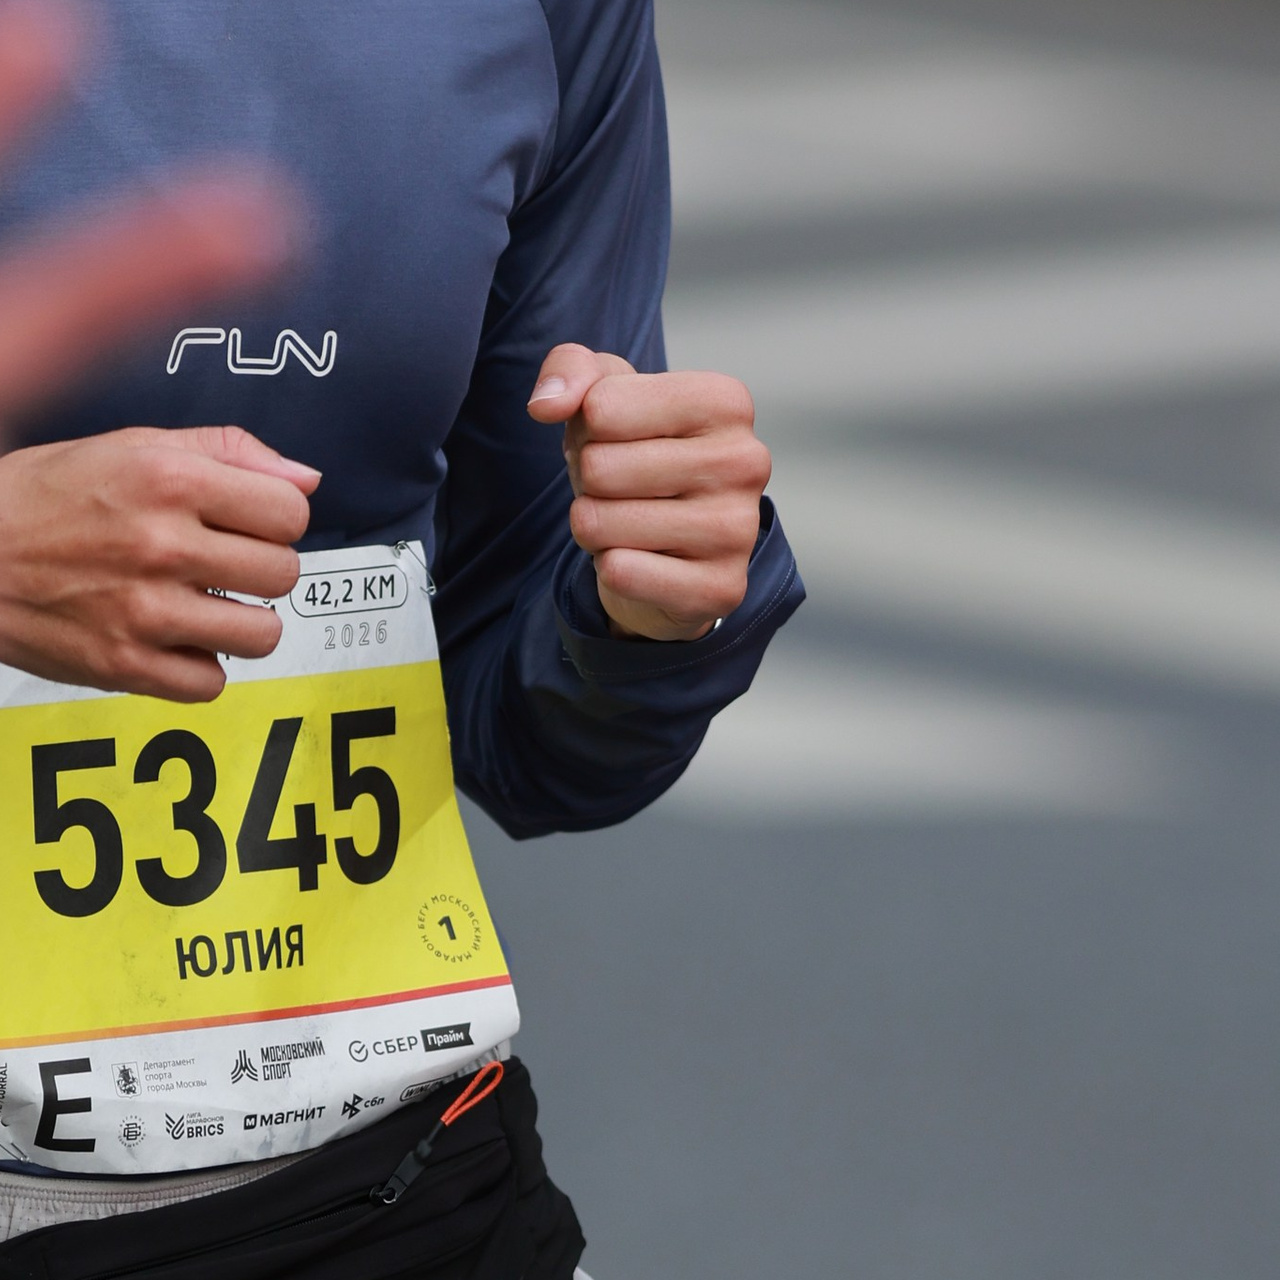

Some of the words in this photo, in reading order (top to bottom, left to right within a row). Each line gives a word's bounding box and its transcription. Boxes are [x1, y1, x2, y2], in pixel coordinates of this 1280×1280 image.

[305, 579, 354, 609] 42,2
[324, 620, 388, 650] 2026
[30, 706, 402, 919] 5345
[438, 915, 457, 941] 1
[176, 923, 305, 981] ЮЛИЯ
[260, 1036, 326, 1063] МОСКОВСКИЙ
[372, 1035, 419, 1056] СБЕР
[426, 1029, 465, 1047] Прайм
[143, 1058, 196, 1071] Департамент
[145, 1070, 173, 1082] спорта
[262, 1062, 292, 1081] СПОРТ
[146, 1083, 175, 1094] города
[175, 1080, 208, 1090] Москвы
[33, 1057, 97, 1153] E
[363, 1096, 385, 1108] сбп
[186, 1116, 225, 1125] МАРАФОНОВ
[186, 1123, 225, 1139] BRICS
